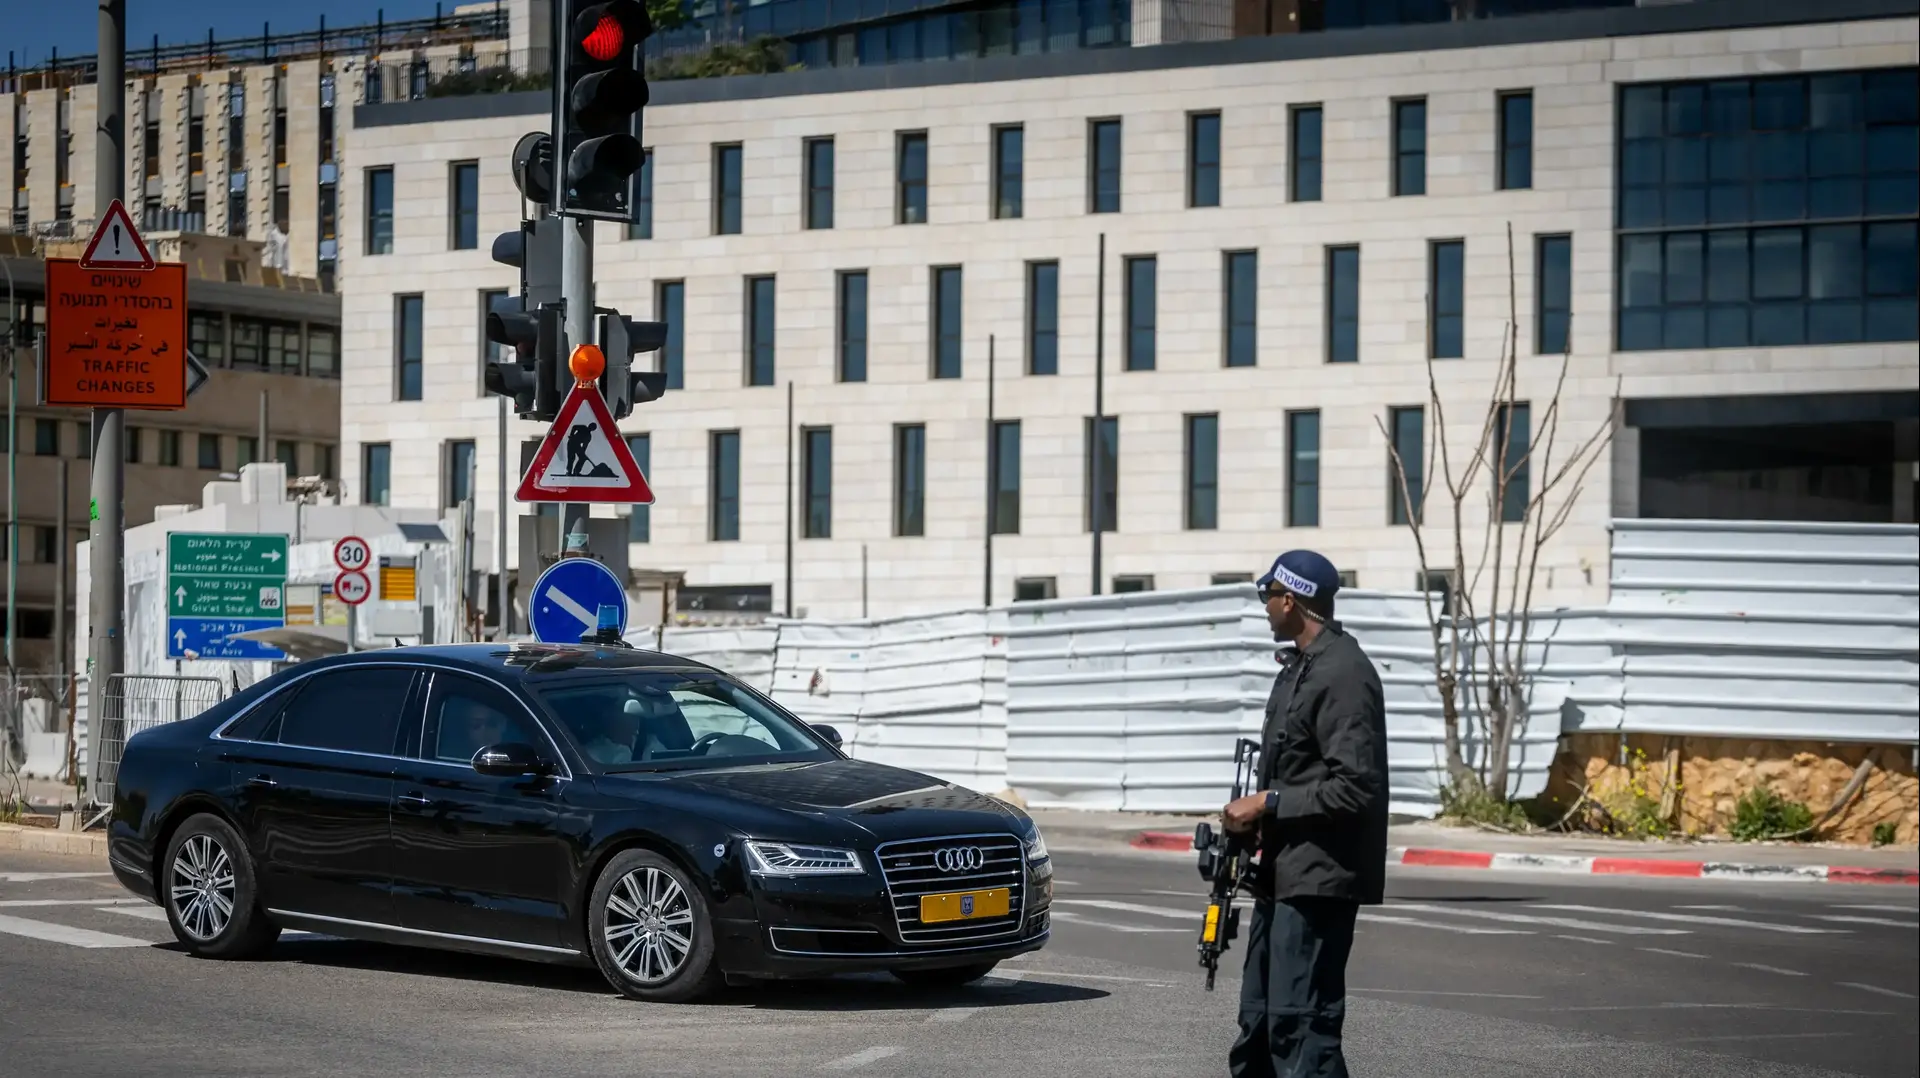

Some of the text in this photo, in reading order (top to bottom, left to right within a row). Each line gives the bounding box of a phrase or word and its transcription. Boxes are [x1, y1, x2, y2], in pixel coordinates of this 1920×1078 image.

[91, 274, 142, 288] שינויים
[59, 292, 173, 310] בהסדרי תנועה
[151, 339, 169, 357] في
[82, 359, 150, 374] TRAFFIC
[76, 379, 156, 394] CHANGES
[187, 538, 252, 552] קרית הלאום
[341, 546, 364, 563] 30
[174, 563, 265, 573] National Precinct
[193, 579, 252, 590] גבעת שאול
[1277, 569, 1314, 594] משטרה
[199, 620, 246, 632] תל אביב
[202, 646, 243, 656] Tel Aviv
